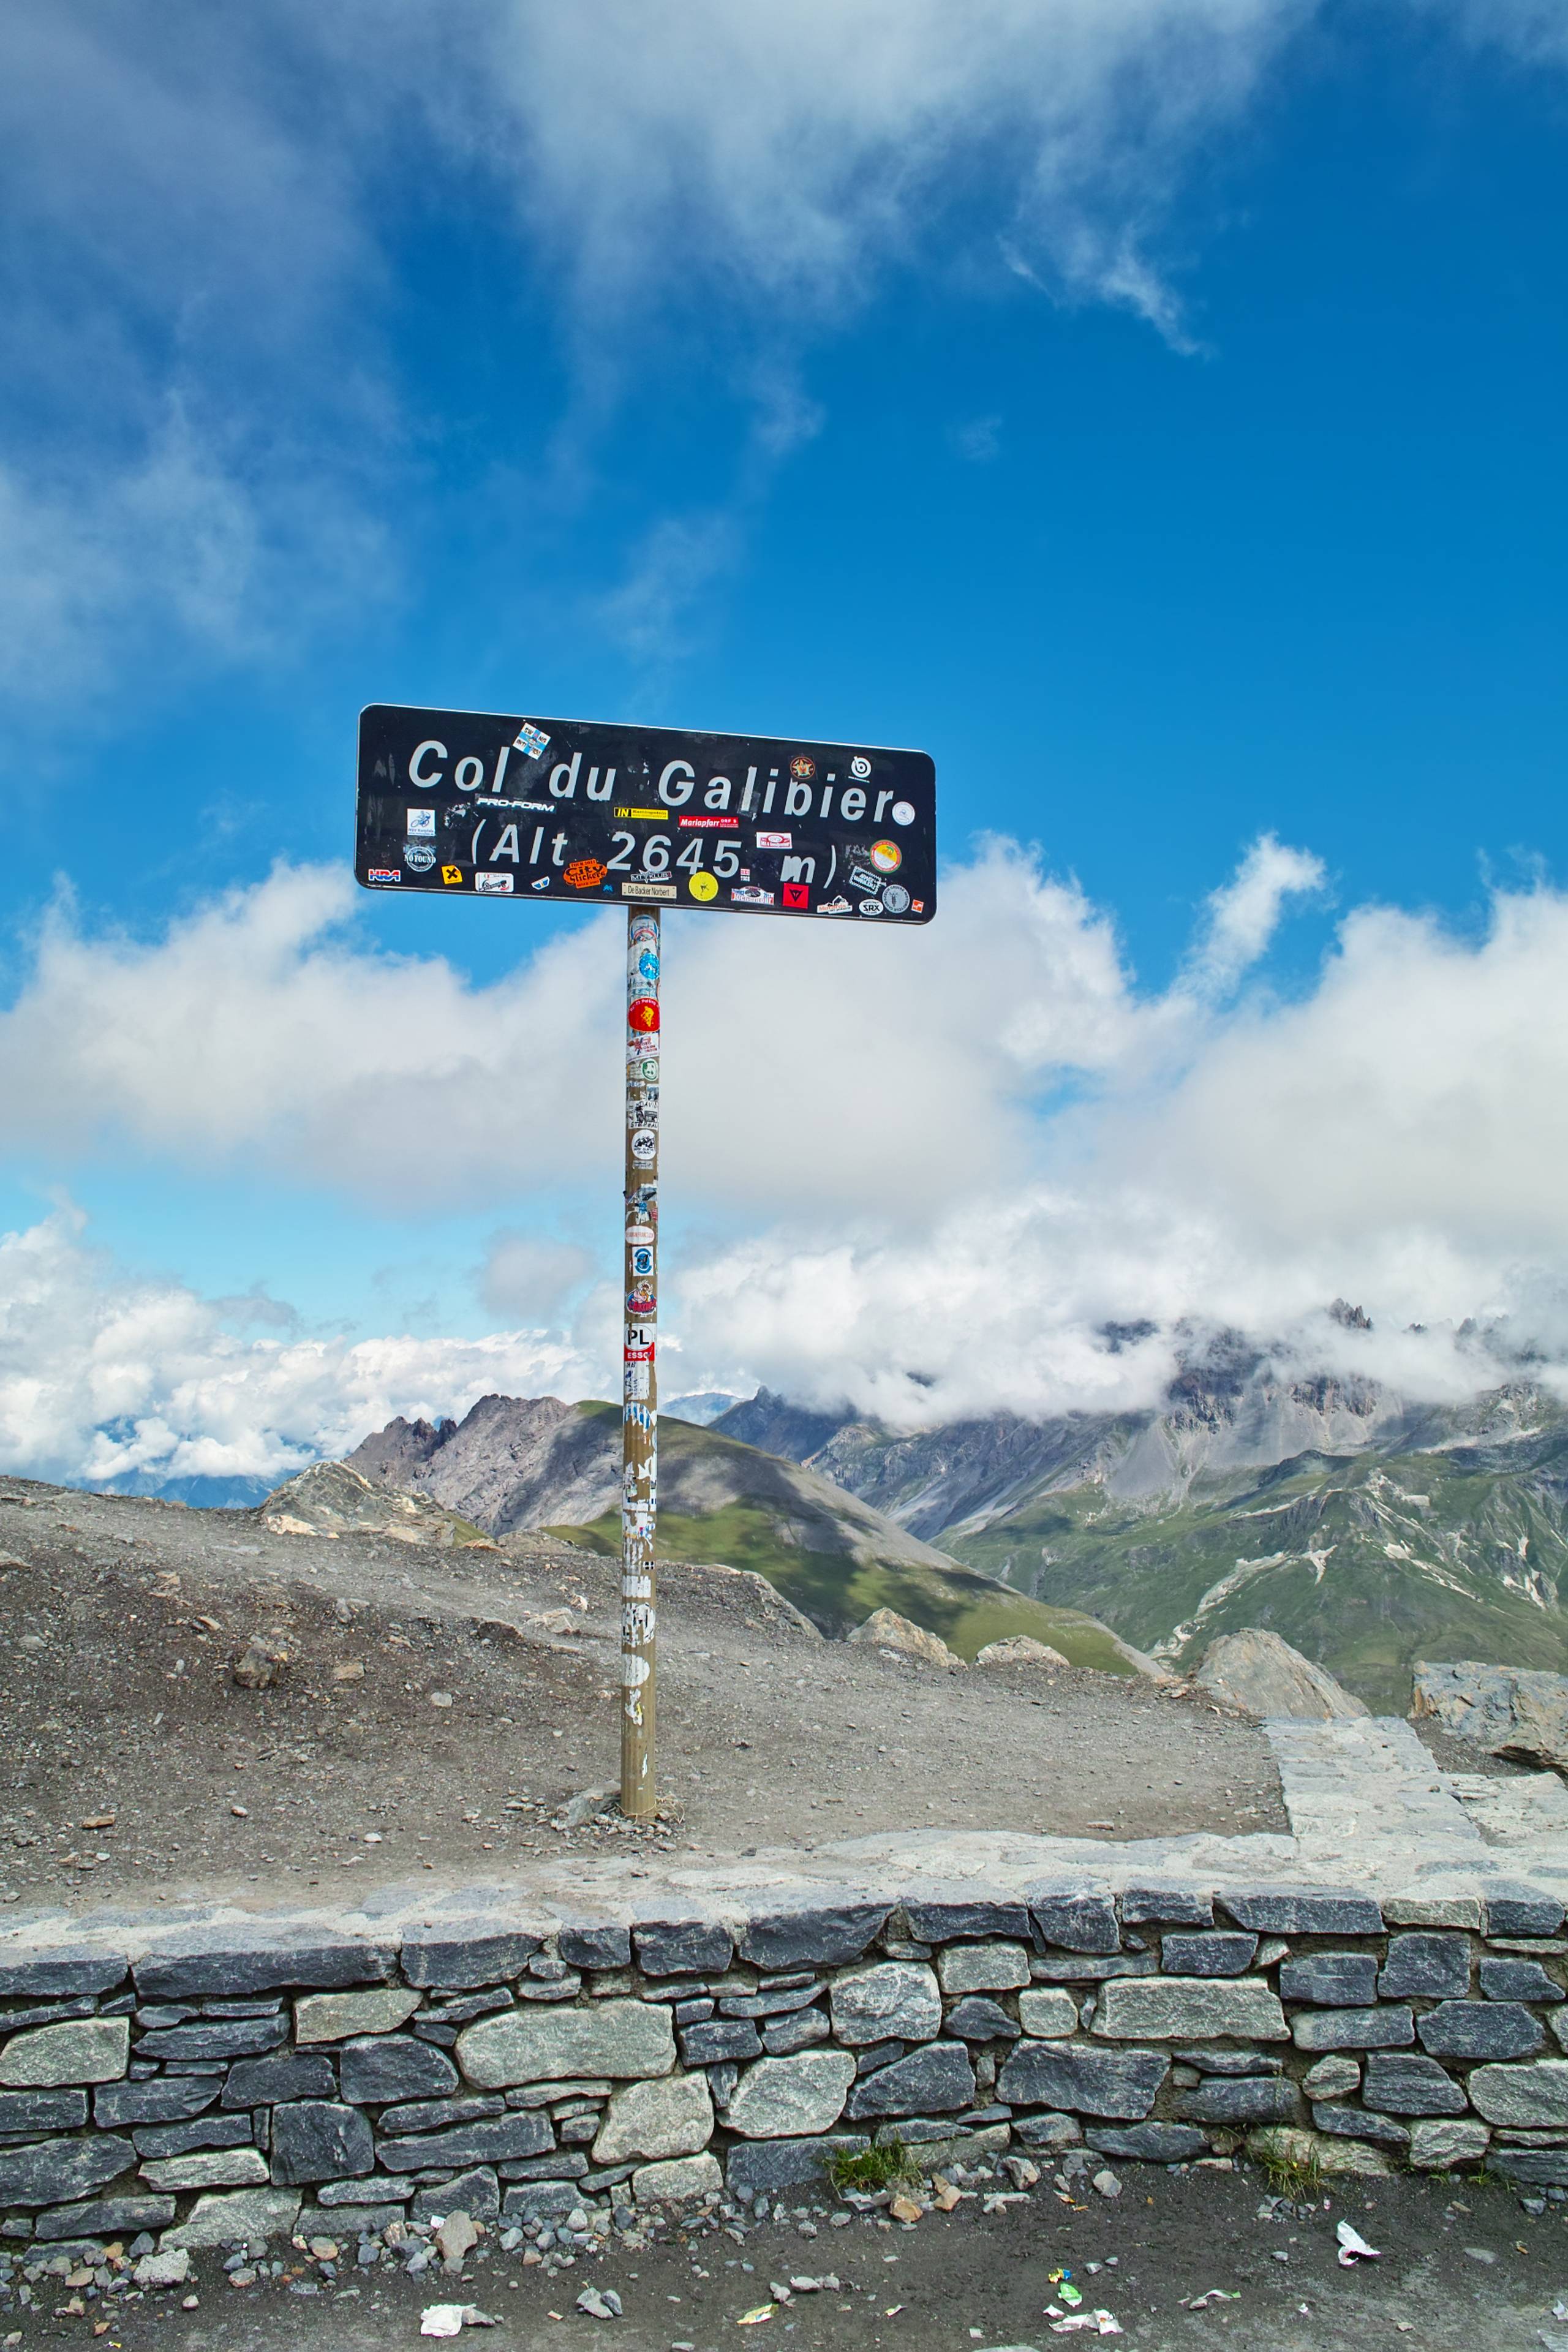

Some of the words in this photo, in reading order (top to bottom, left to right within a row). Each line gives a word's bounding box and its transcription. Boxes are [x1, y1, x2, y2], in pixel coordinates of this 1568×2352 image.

[409, 740, 510, 793] Col
[549, 752, 616, 801] du
[658, 760, 894, 823] Galibier
[477, 797, 554, 812] PRO-FORM
[617, 809, 629, 817] IN
[680, 818, 719, 827] Mariapfarr
[472, 819, 568, 866] (Alt
[606, 831, 742, 878] 2645
[780, 845, 835, 889] m)
[566, 865, 603, 876] City
[570, 871, 606, 883] Slickers
[652, 888, 669, 897] Norbert
[628, 1329, 649, 1345] PL
